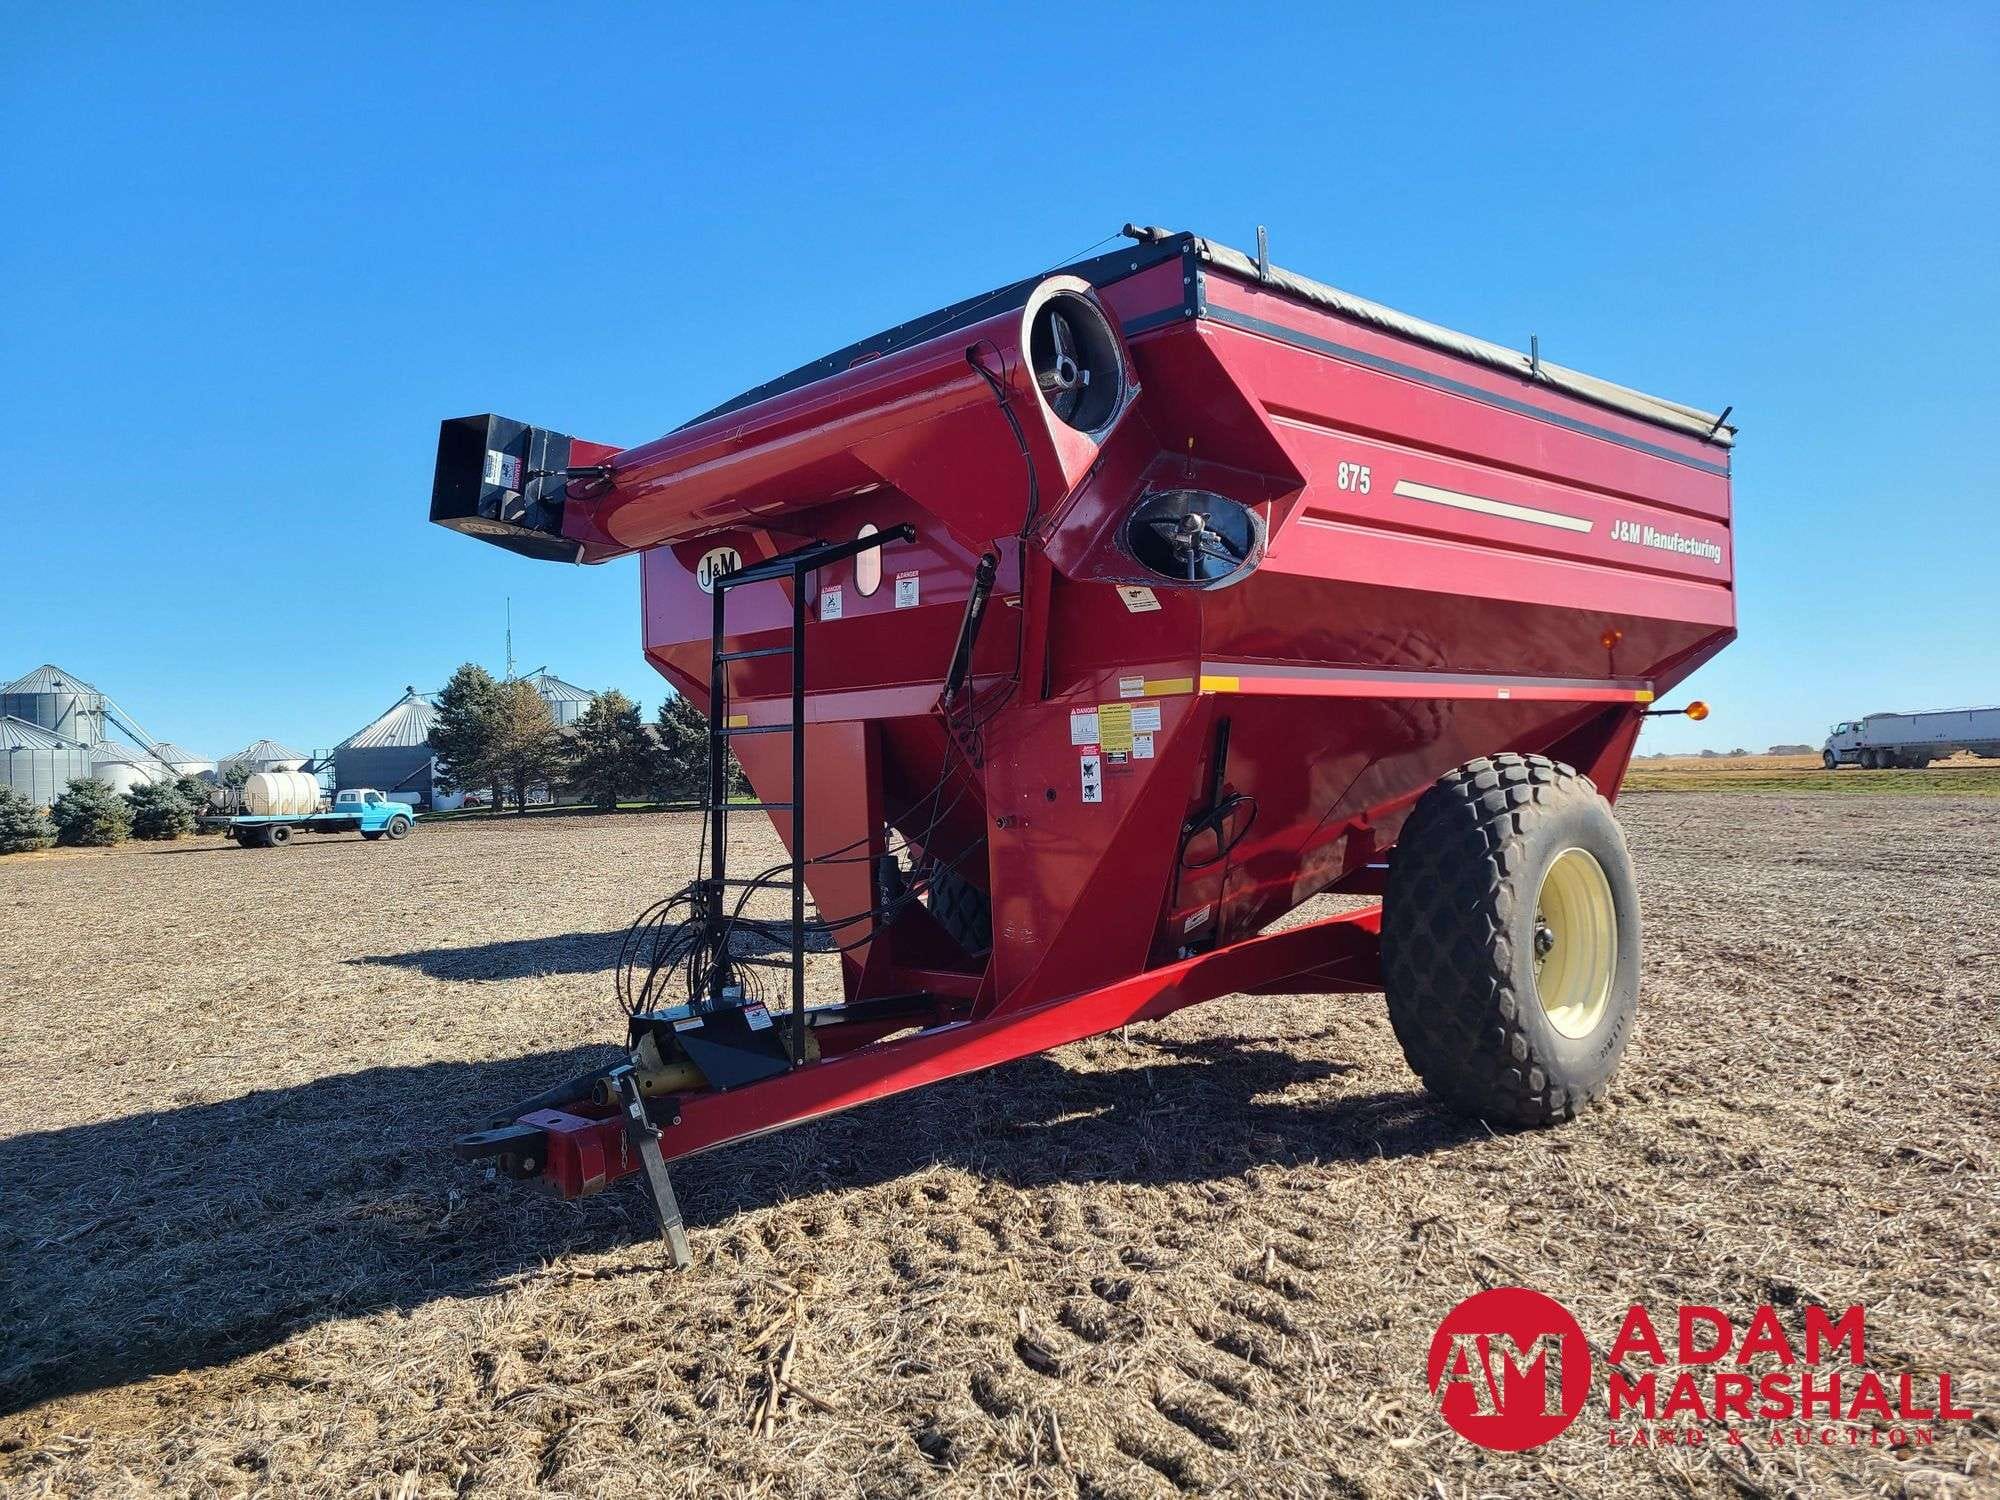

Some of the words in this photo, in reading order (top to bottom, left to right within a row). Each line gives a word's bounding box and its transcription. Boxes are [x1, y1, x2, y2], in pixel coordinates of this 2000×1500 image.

[1337, 460, 1371, 495] 875
[1610, 519, 1640, 544] J&M
[1642, 526, 1721, 564] Manufacturing
[700, 551, 735, 587] J&M
